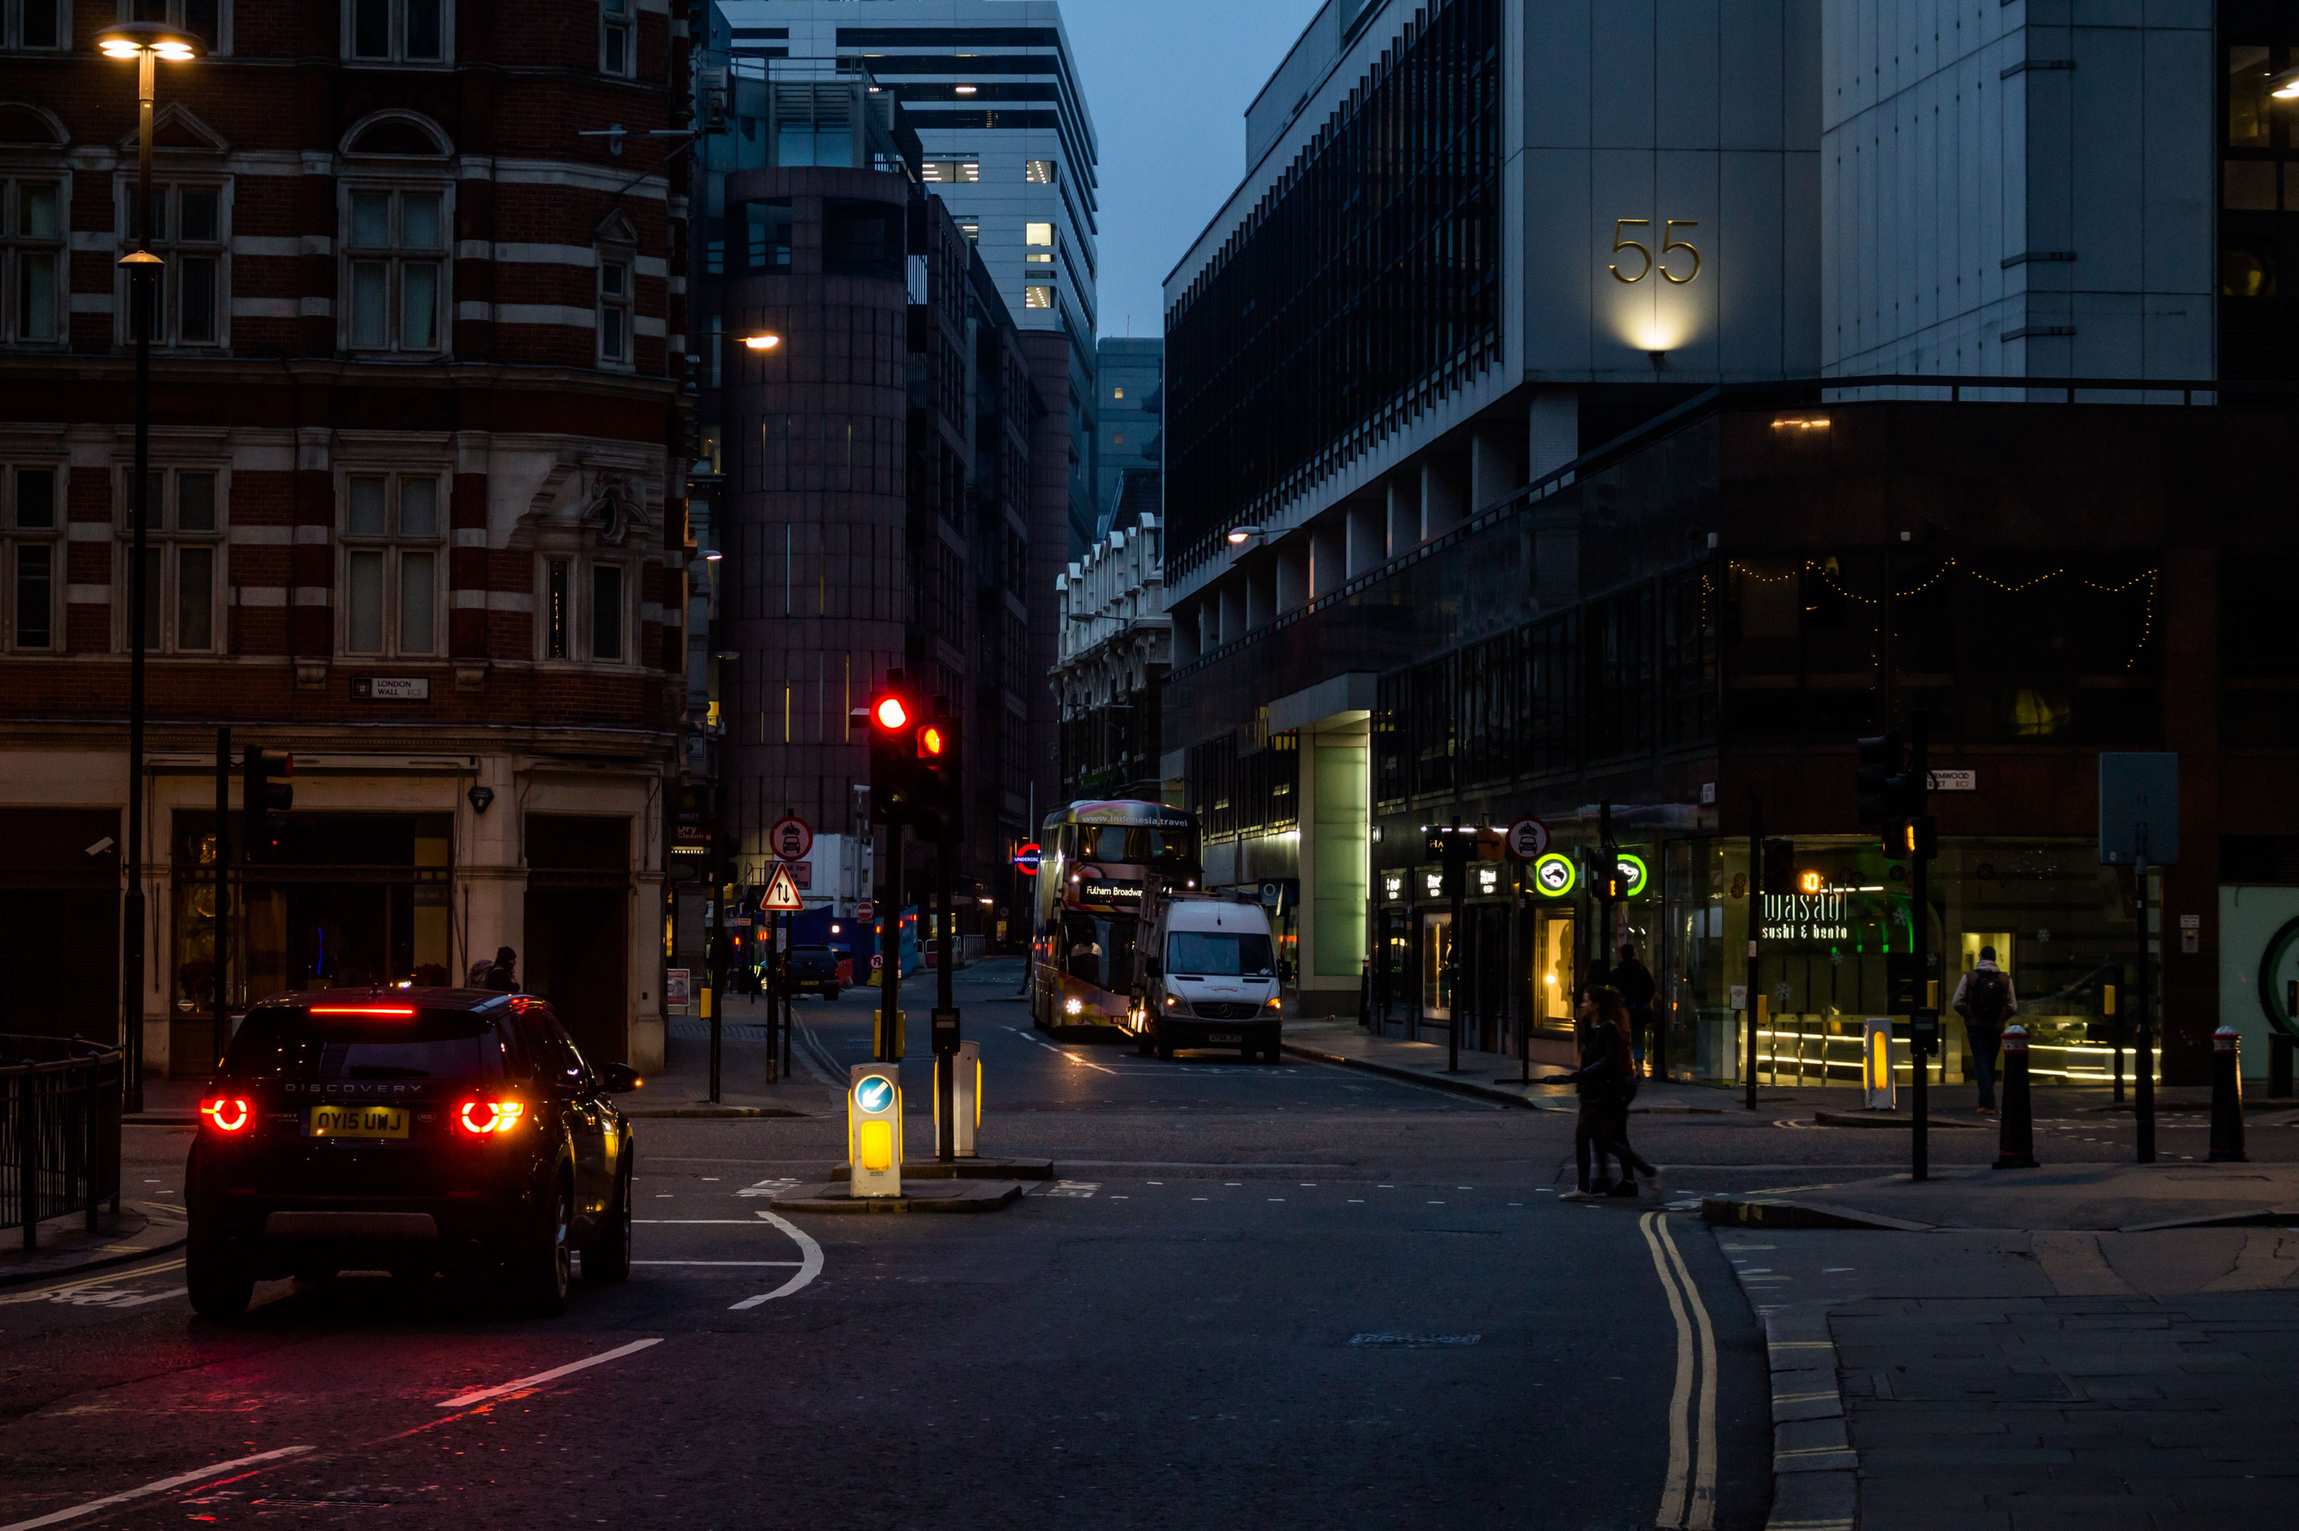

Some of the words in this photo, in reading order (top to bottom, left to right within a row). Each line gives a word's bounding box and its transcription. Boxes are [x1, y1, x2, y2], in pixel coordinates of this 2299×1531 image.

[1608, 217, 1700, 285] 55
[377, 680, 411, 688] LONDON
[377, 688, 399, 696] WALL
[1086, 885, 1112, 896] Fulham
[1763, 882, 1848, 922] wasabi
[1761, 923, 1796, 940] sushi
[1800, 924, 1808, 940] &
[1813, 923, 1848, 940] bento
[284, 1083, 423, 1094] DISCOVERY
[317, 1112, 360, 1131] OY15
[364, 1113, 401, 1131] UWJ
